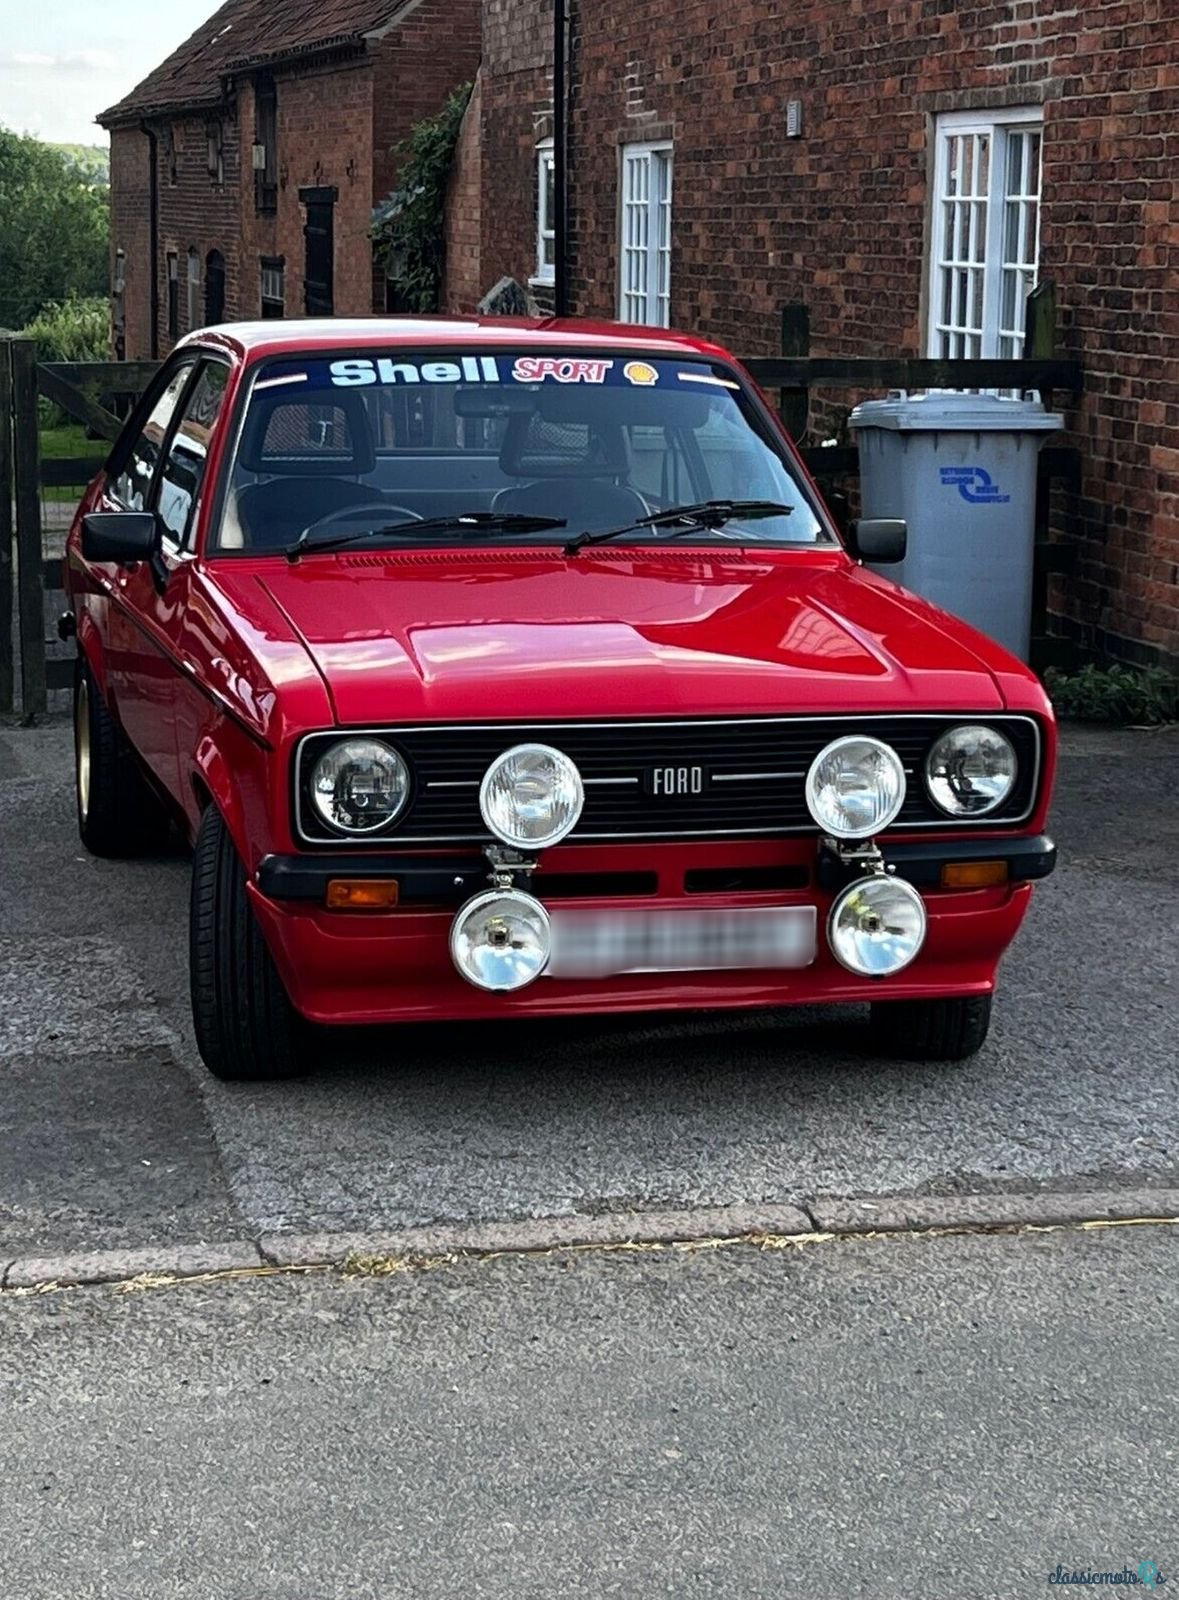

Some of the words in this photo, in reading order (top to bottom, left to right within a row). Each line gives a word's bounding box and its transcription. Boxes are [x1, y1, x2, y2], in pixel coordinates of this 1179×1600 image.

[330, 357, 499, 387] Shell
[512, 358, 614, 384] SPORT
[653, 767, 702, 795] FORD
